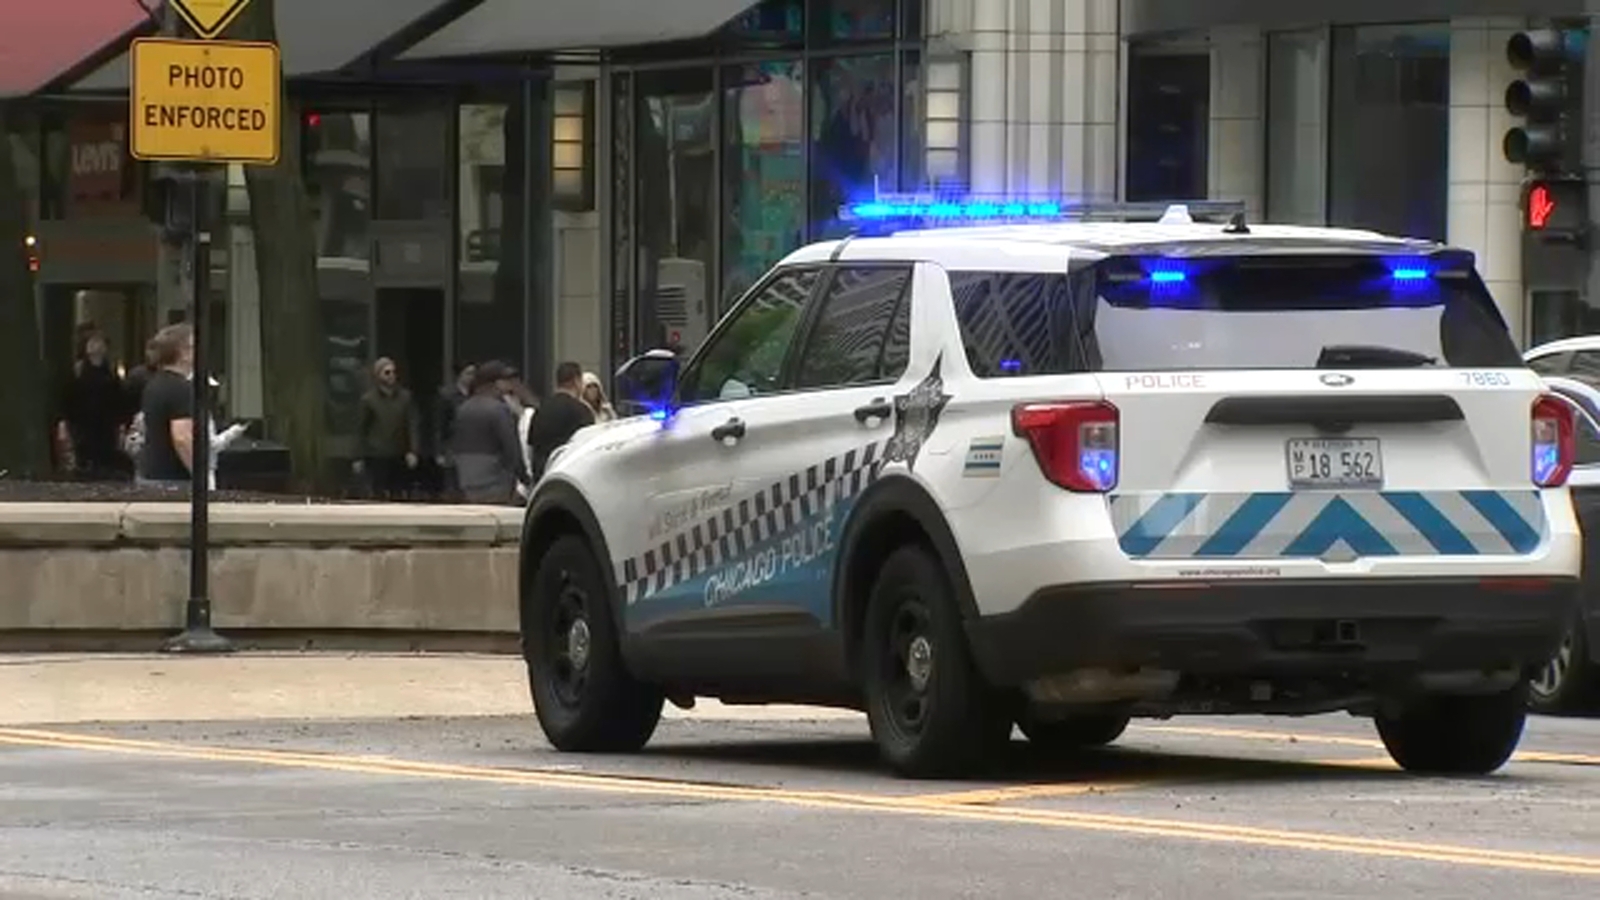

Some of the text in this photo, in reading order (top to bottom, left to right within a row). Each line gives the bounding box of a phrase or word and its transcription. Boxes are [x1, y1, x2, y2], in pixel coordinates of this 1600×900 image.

[168, 64, 244, 90] PHOTO
[144, 104, 267, 131] ENFORCED
[1125, 374, 1206, 390] POLICE
[1459, 372, 1511, 386] 7860
[1309, 451, 1375, 479] 18 562
[704, 515, 834, 608] CHICAGO POLICE
